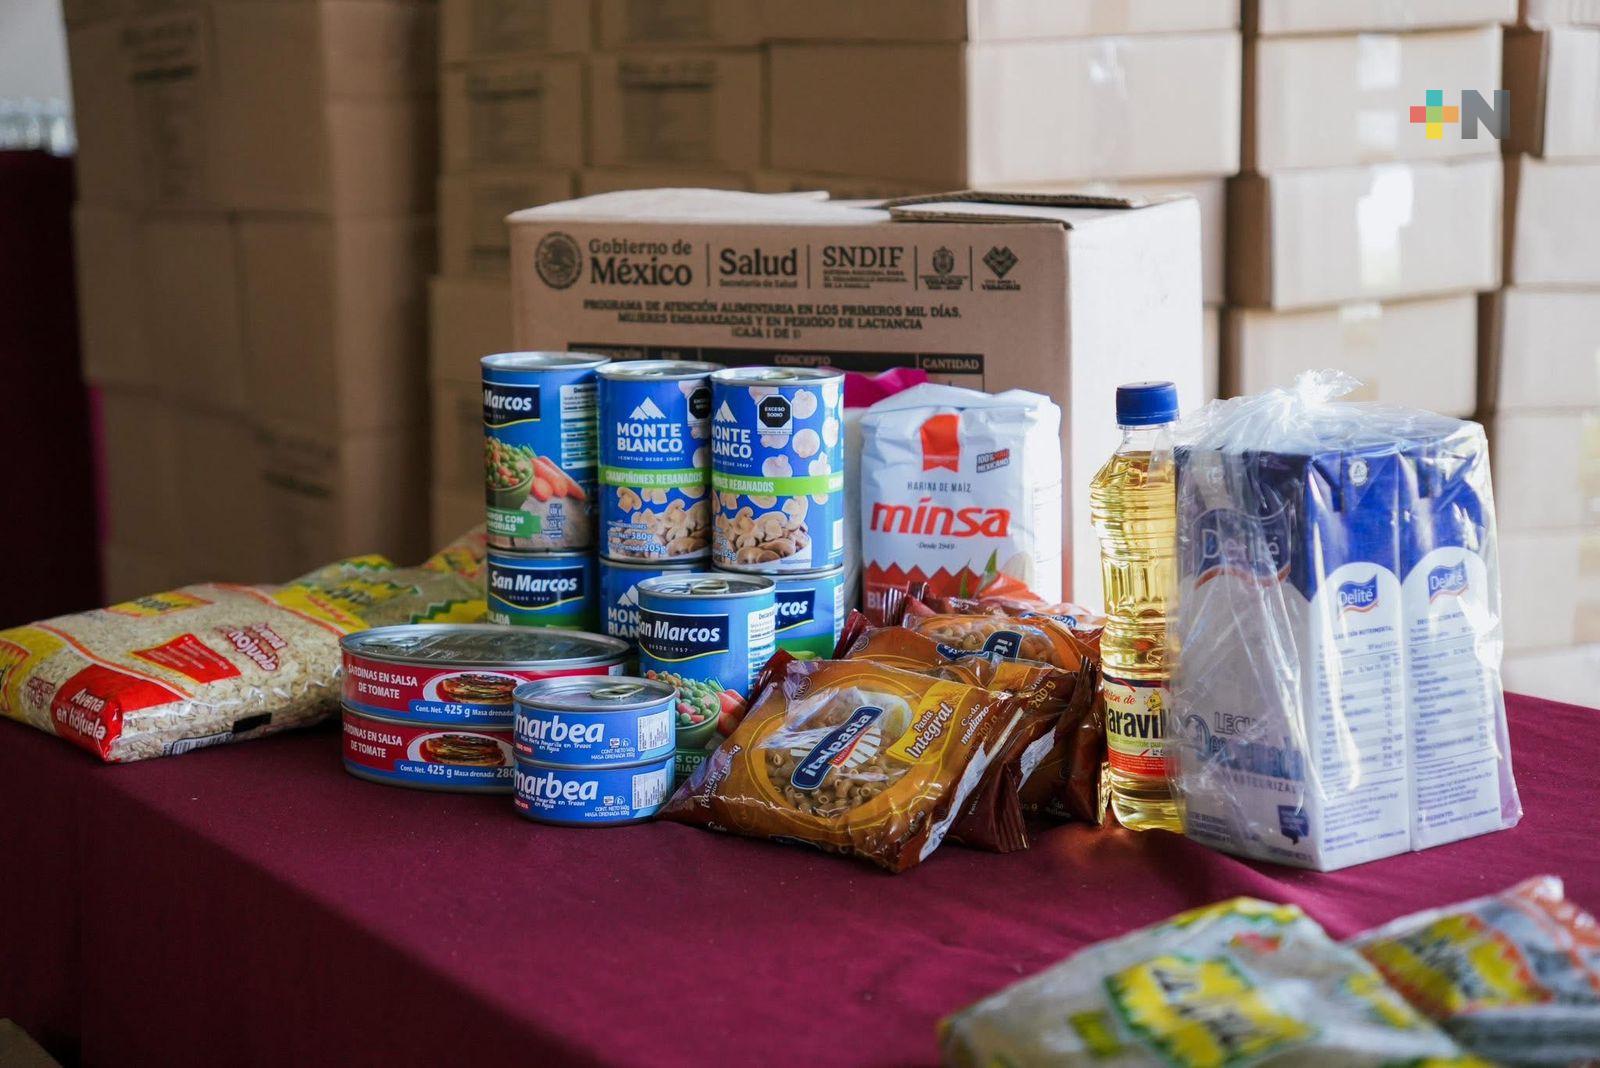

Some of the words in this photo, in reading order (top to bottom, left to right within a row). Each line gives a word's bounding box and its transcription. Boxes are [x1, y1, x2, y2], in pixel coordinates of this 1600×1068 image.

[589, 239, 667, 255] Gobierno
[672, 240, 692, 256] de
[719, 248, 798, 277] Salud
[823, 246, 904, 268] SNDIF
[590, 256, 692, 286] México
[583, 300, 643, 311] PROGRAMA
[646, 301, 660, 312] DE
[663, 298, 717, 313] ATENCIÓN
[720, 302, 795, 315] ALIMENTARIA
[797, 304, 813, 315] EN
[816, 304, 839, 316] LOS
[842, 304, 901, 318] PRIMEROS
[905, 306, 927, 318] MIL
[618, 312, 668, 323] MUJERES
[670, 313, 752, 325] EMBARAZADAS
[755, 314, 763, 325] Y
[766, 315, 781, 326] EN
[784, 316, 835, 328] PERIODO
[838, 317, 854, 329] DE
[857, 317, 923, 330] LACTANCIA
[774, 328, 789, 339] DE
[774, 354, 832, 365] CONCEPTO
[922, 358, 980, 370] CANTIDAD
[616, 421, 682, 438] MONTE
[617, 437, 683, 454] BLANCO
[711, 440, 752, 459] LANCO
[656, 473, 703, 485] REBANADOS
[729, 479, 774, 493] REBANADOS
[907, 481, 937, 492] HARINA
[940, 482, 949, 492] DE
[504, 514, 524, 524] CON
[491, 570, 513, 590] San
[515, 574, 578, 593] Marcos
[1338, 586, 1374, 606] Delité
[608, 607, 640, 624] MON
[774, 600, 808, 616] rcos
[608, 621, 639, 638] BLAN
[654, 620, 720, 643] Marcos
[348, 664, 378, 681] SARDINAS
[379, 671, 390, 683] EN
[391, 674, 418, 687] SALSA
[71, 687, 105, 712] Avena
[358, 682, 367, 693] DE
[369, 684, 400, 699] TOMATE
[1029, 690, 1049, 709] 200
[1046, 680, 1057, 692] g
[1123, 694, 1136, 705] de
[415, 705, 430, 713] Cont.
[431, 706, 443, 714] Net.
[444, 704, 462, 716] 425
[464, 708, 470, 718] g
[961, 703, 981, 727] Codo
[56, 707, 68, 724] en
[69, 706, 107, 740] hojuela
[515, 714, 605, 743] marbea
[904, 701, 954, 759] Integral
[914, 709, 935, 733] Pasta
[960, 705, 990, 745] mediano
[367, 730, 377, 742] EN
[378, 732, 403, 747] SALSA
[801, 714, 873, 777] italpasta
[350, 740, 359, 751] DE
[359, 742, 386, 758] TOMATE
[400, 764, 413, 772] Cont.
[414, 765, 426, 774] Net.
[427, 764, 445, 775] 425
[447, 767, 452, 778] g
[469, 770, 495, 778] drenada
[513, 769, 599, 802] marbea
